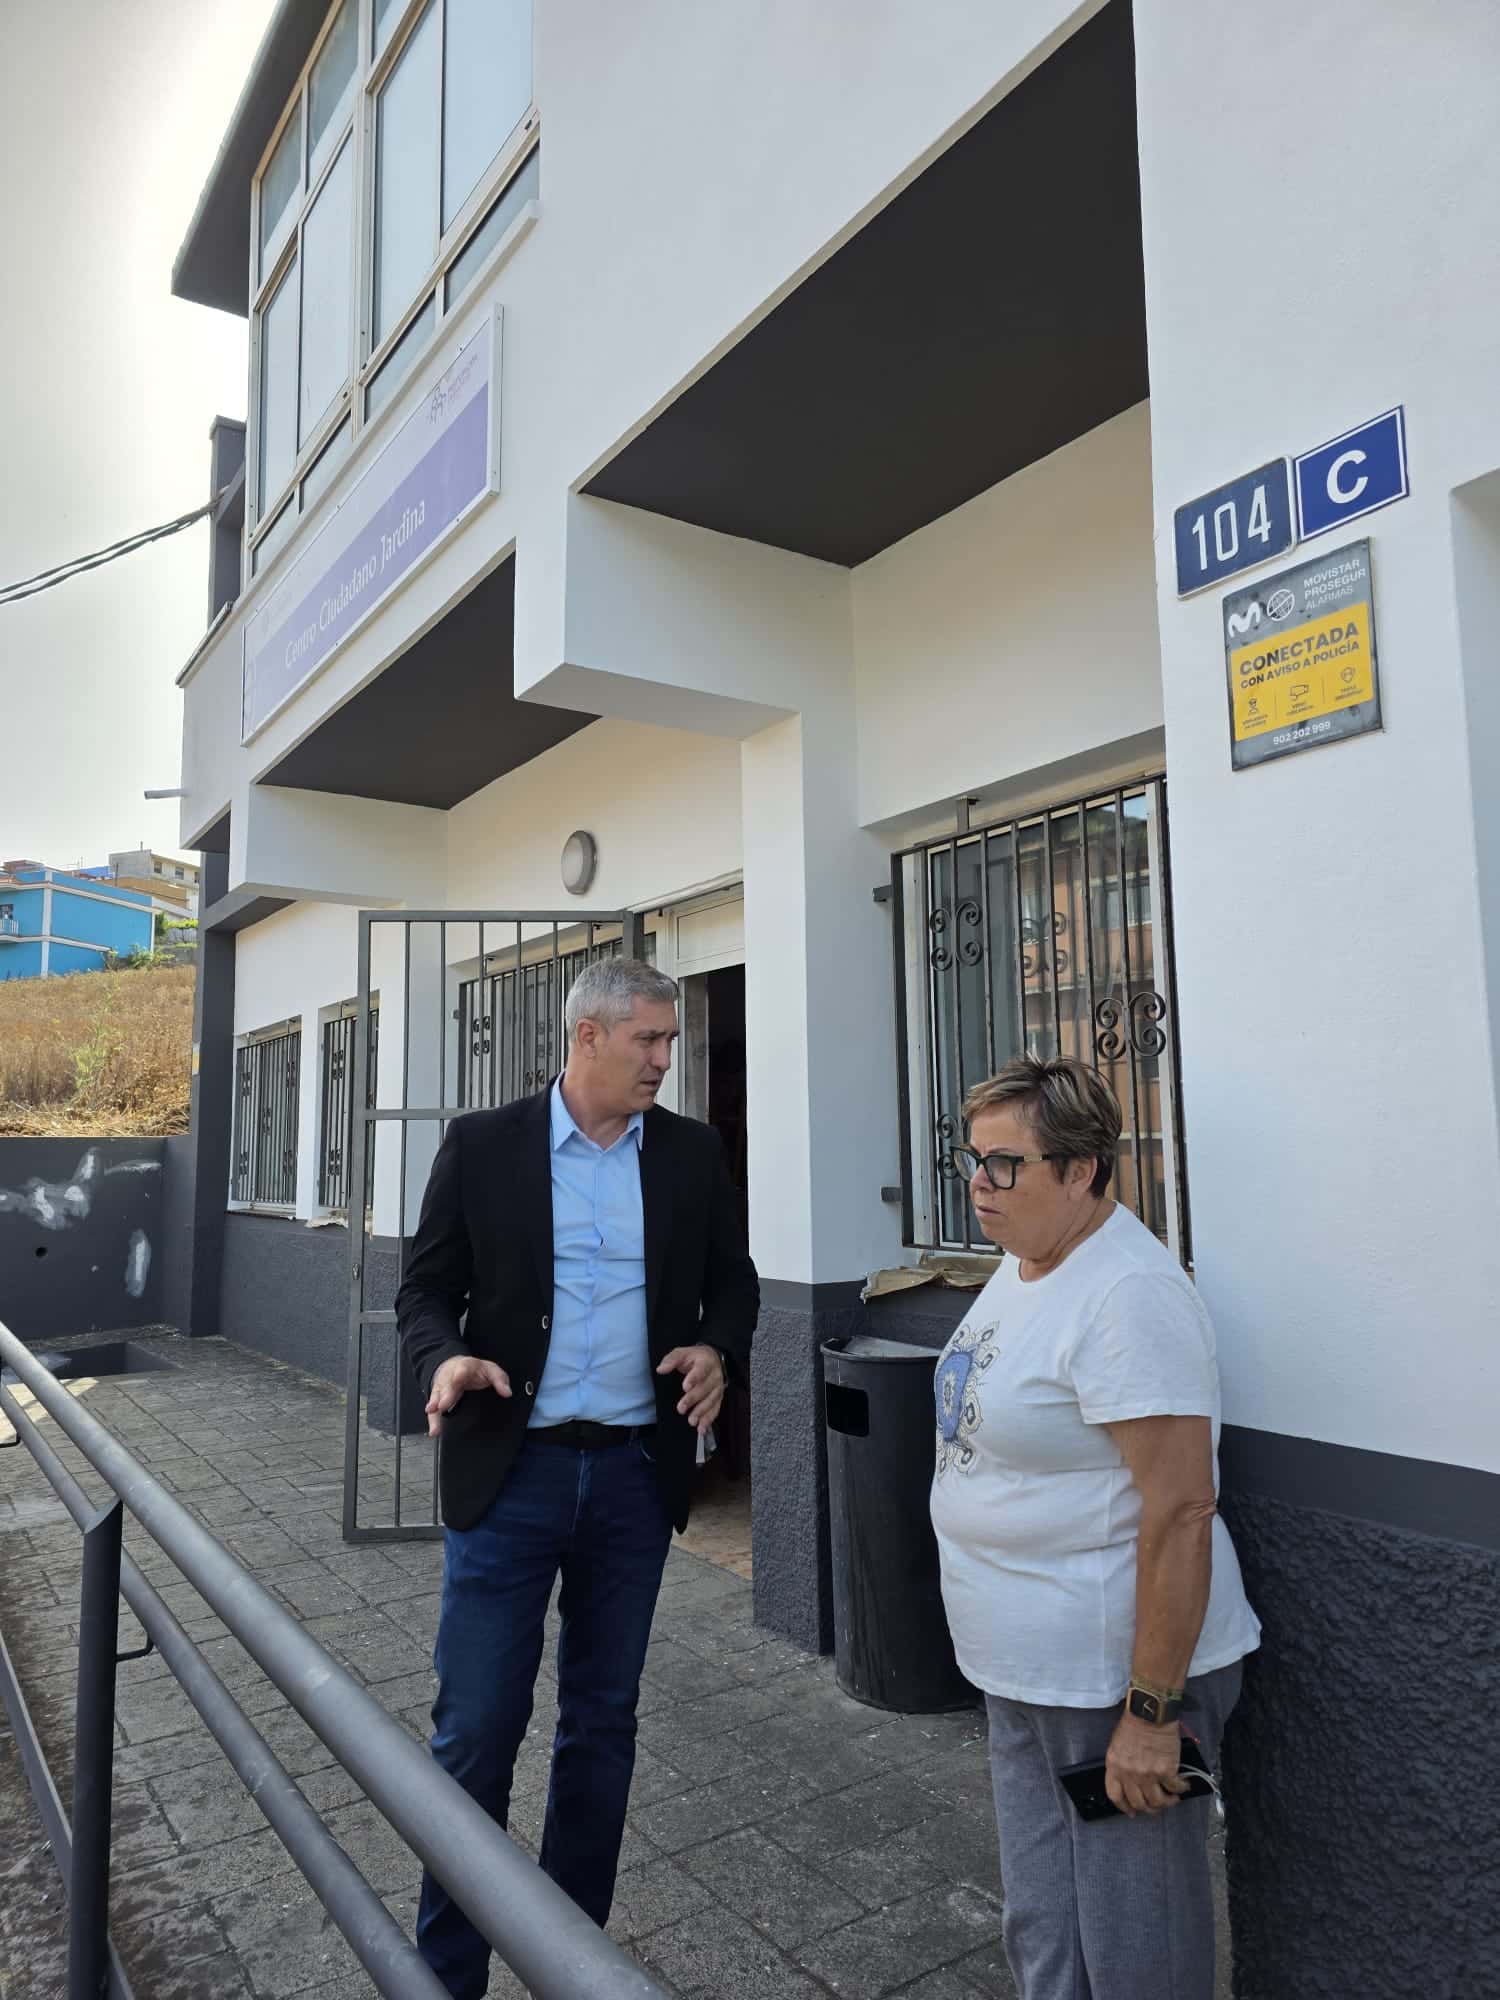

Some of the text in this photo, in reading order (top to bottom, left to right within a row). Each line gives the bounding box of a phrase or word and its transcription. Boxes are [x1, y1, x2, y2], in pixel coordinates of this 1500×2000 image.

[1326, 449, 1369, 504] C
[1192, 484, 1272, 571] 104
[284, 499, 425, 669] Centro Ciudadano Jardina
[1304, 559, 1360, 588] MOVISTAR
[1304, 568, 1366, 600] PROSEGUR
[1240, 623, 1358, 675] CONECTADA
[1240, 640, 1359, 689] CON AVISO A POLICÍA
[1273, 732, 1291, 745] 902
[1292, 727, 1311, 740] 202
[1312, 721, 1331, 734] 999
